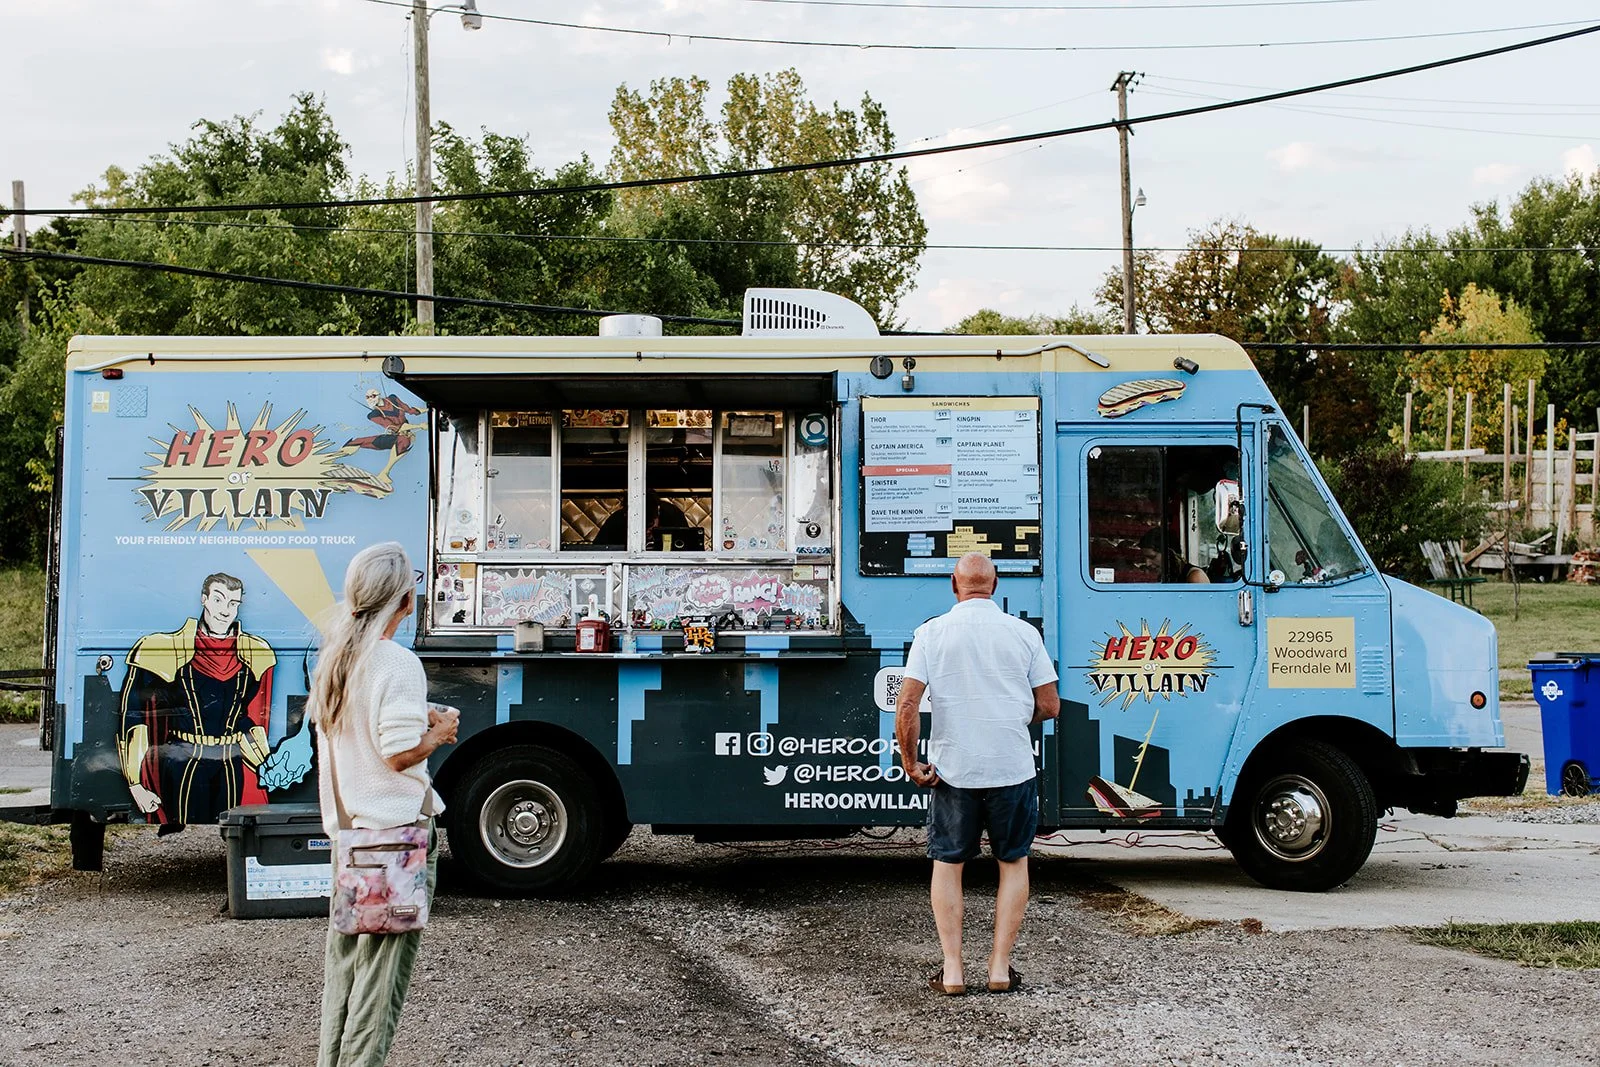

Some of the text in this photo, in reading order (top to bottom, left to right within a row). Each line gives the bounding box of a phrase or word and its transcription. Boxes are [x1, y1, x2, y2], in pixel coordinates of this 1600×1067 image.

[528, 415, 552, 425] KEYMAST
[163, 429, 316, 468] HERO
[227, 471, 252, 485] or
[139, 487, 333, 520] VILLAIN
[115, 535, 356, 546] YOUR FRIENDLY NEIGHBORHOOD FOOD TRUCK
[733, 582, 778, 604] BANG!
[1287, 630, 1333, 643] 22965
[1102, 635, 1198, 661] HERO
[1274, 646, 1347, 660] Woodward
[1142, 661, 1160, 672] or
[1271, 662, 1352, 675] Ferndale MI
[1089, 672, 1212, 693] VILLAIN
[785, 792, 932, 810] HEROORVILLAI
